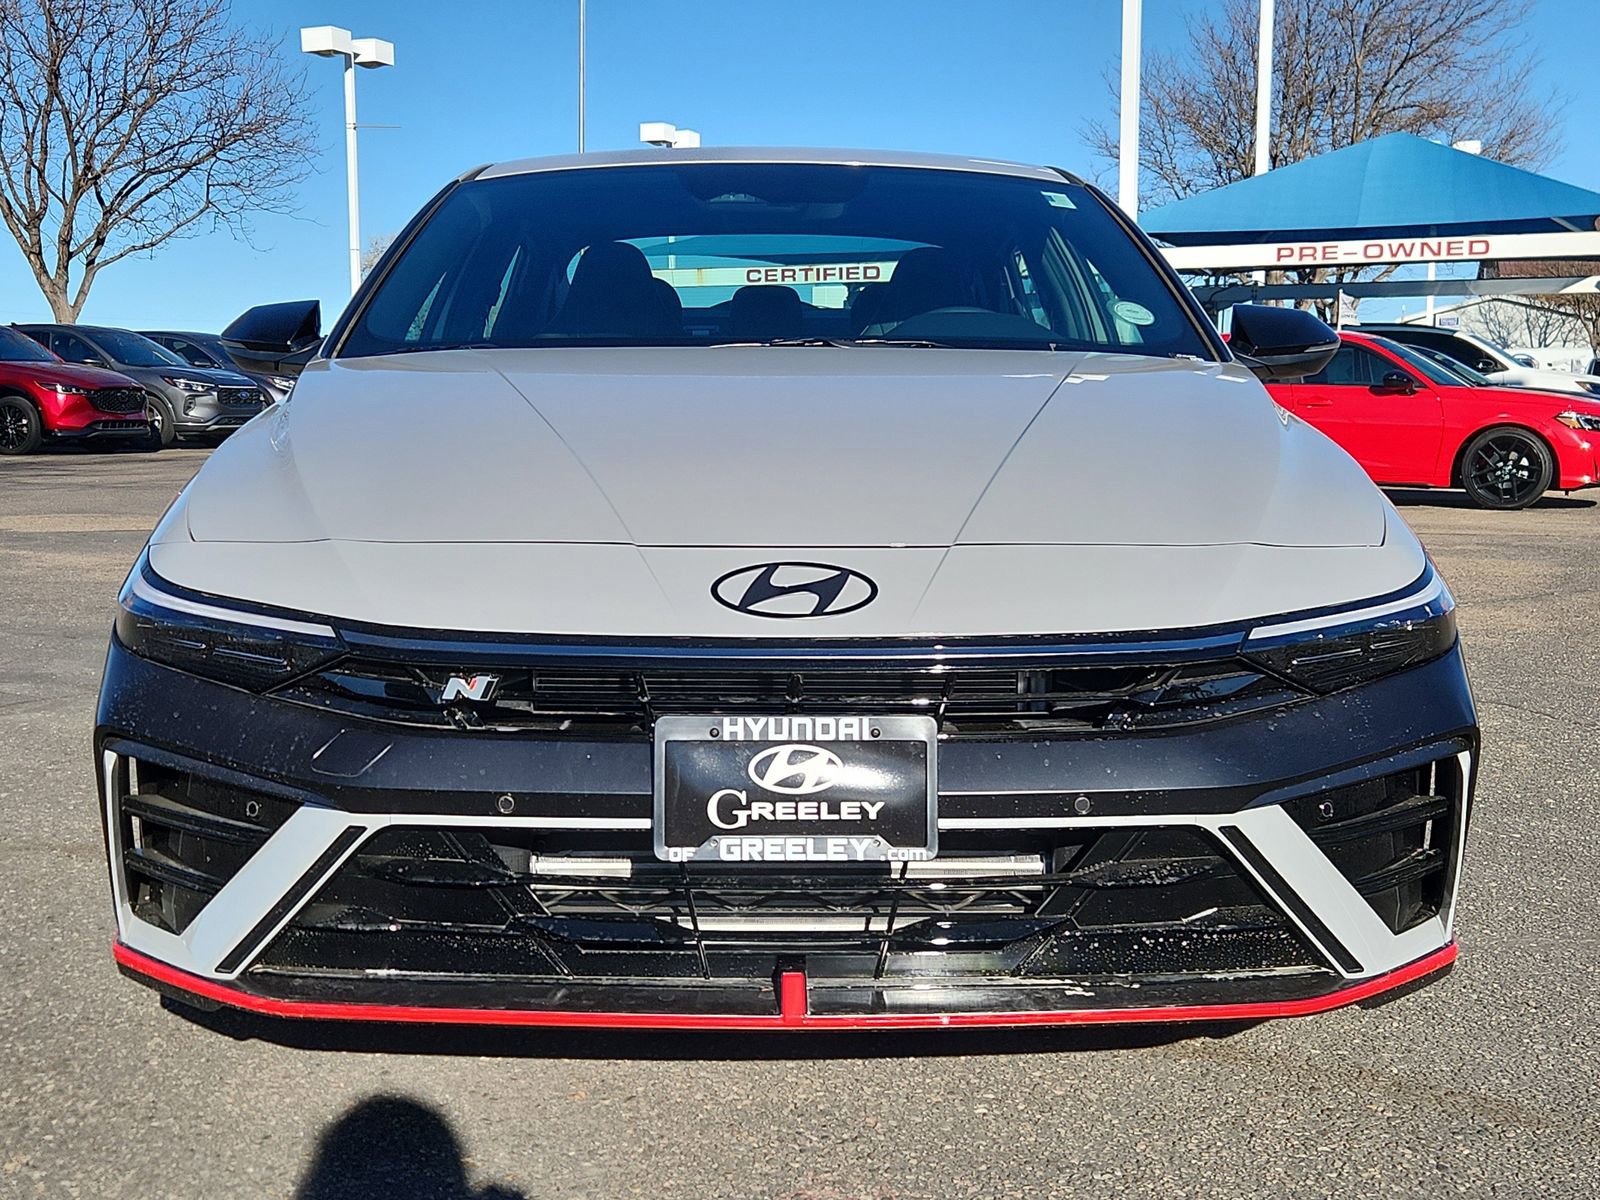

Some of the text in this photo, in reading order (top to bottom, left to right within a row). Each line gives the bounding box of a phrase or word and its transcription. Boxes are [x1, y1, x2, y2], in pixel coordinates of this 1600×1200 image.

[1276, 240, 1490, 262] PRE-OWNED
[746, 266, 880, 283] CERTIFIED
[722, 717, 870, 741] HYUNDAI
[706, 789, 885, 829] GREELEY
[668, 847, 696, 862] OF
[719, 838, 872, 861] GREELEY
